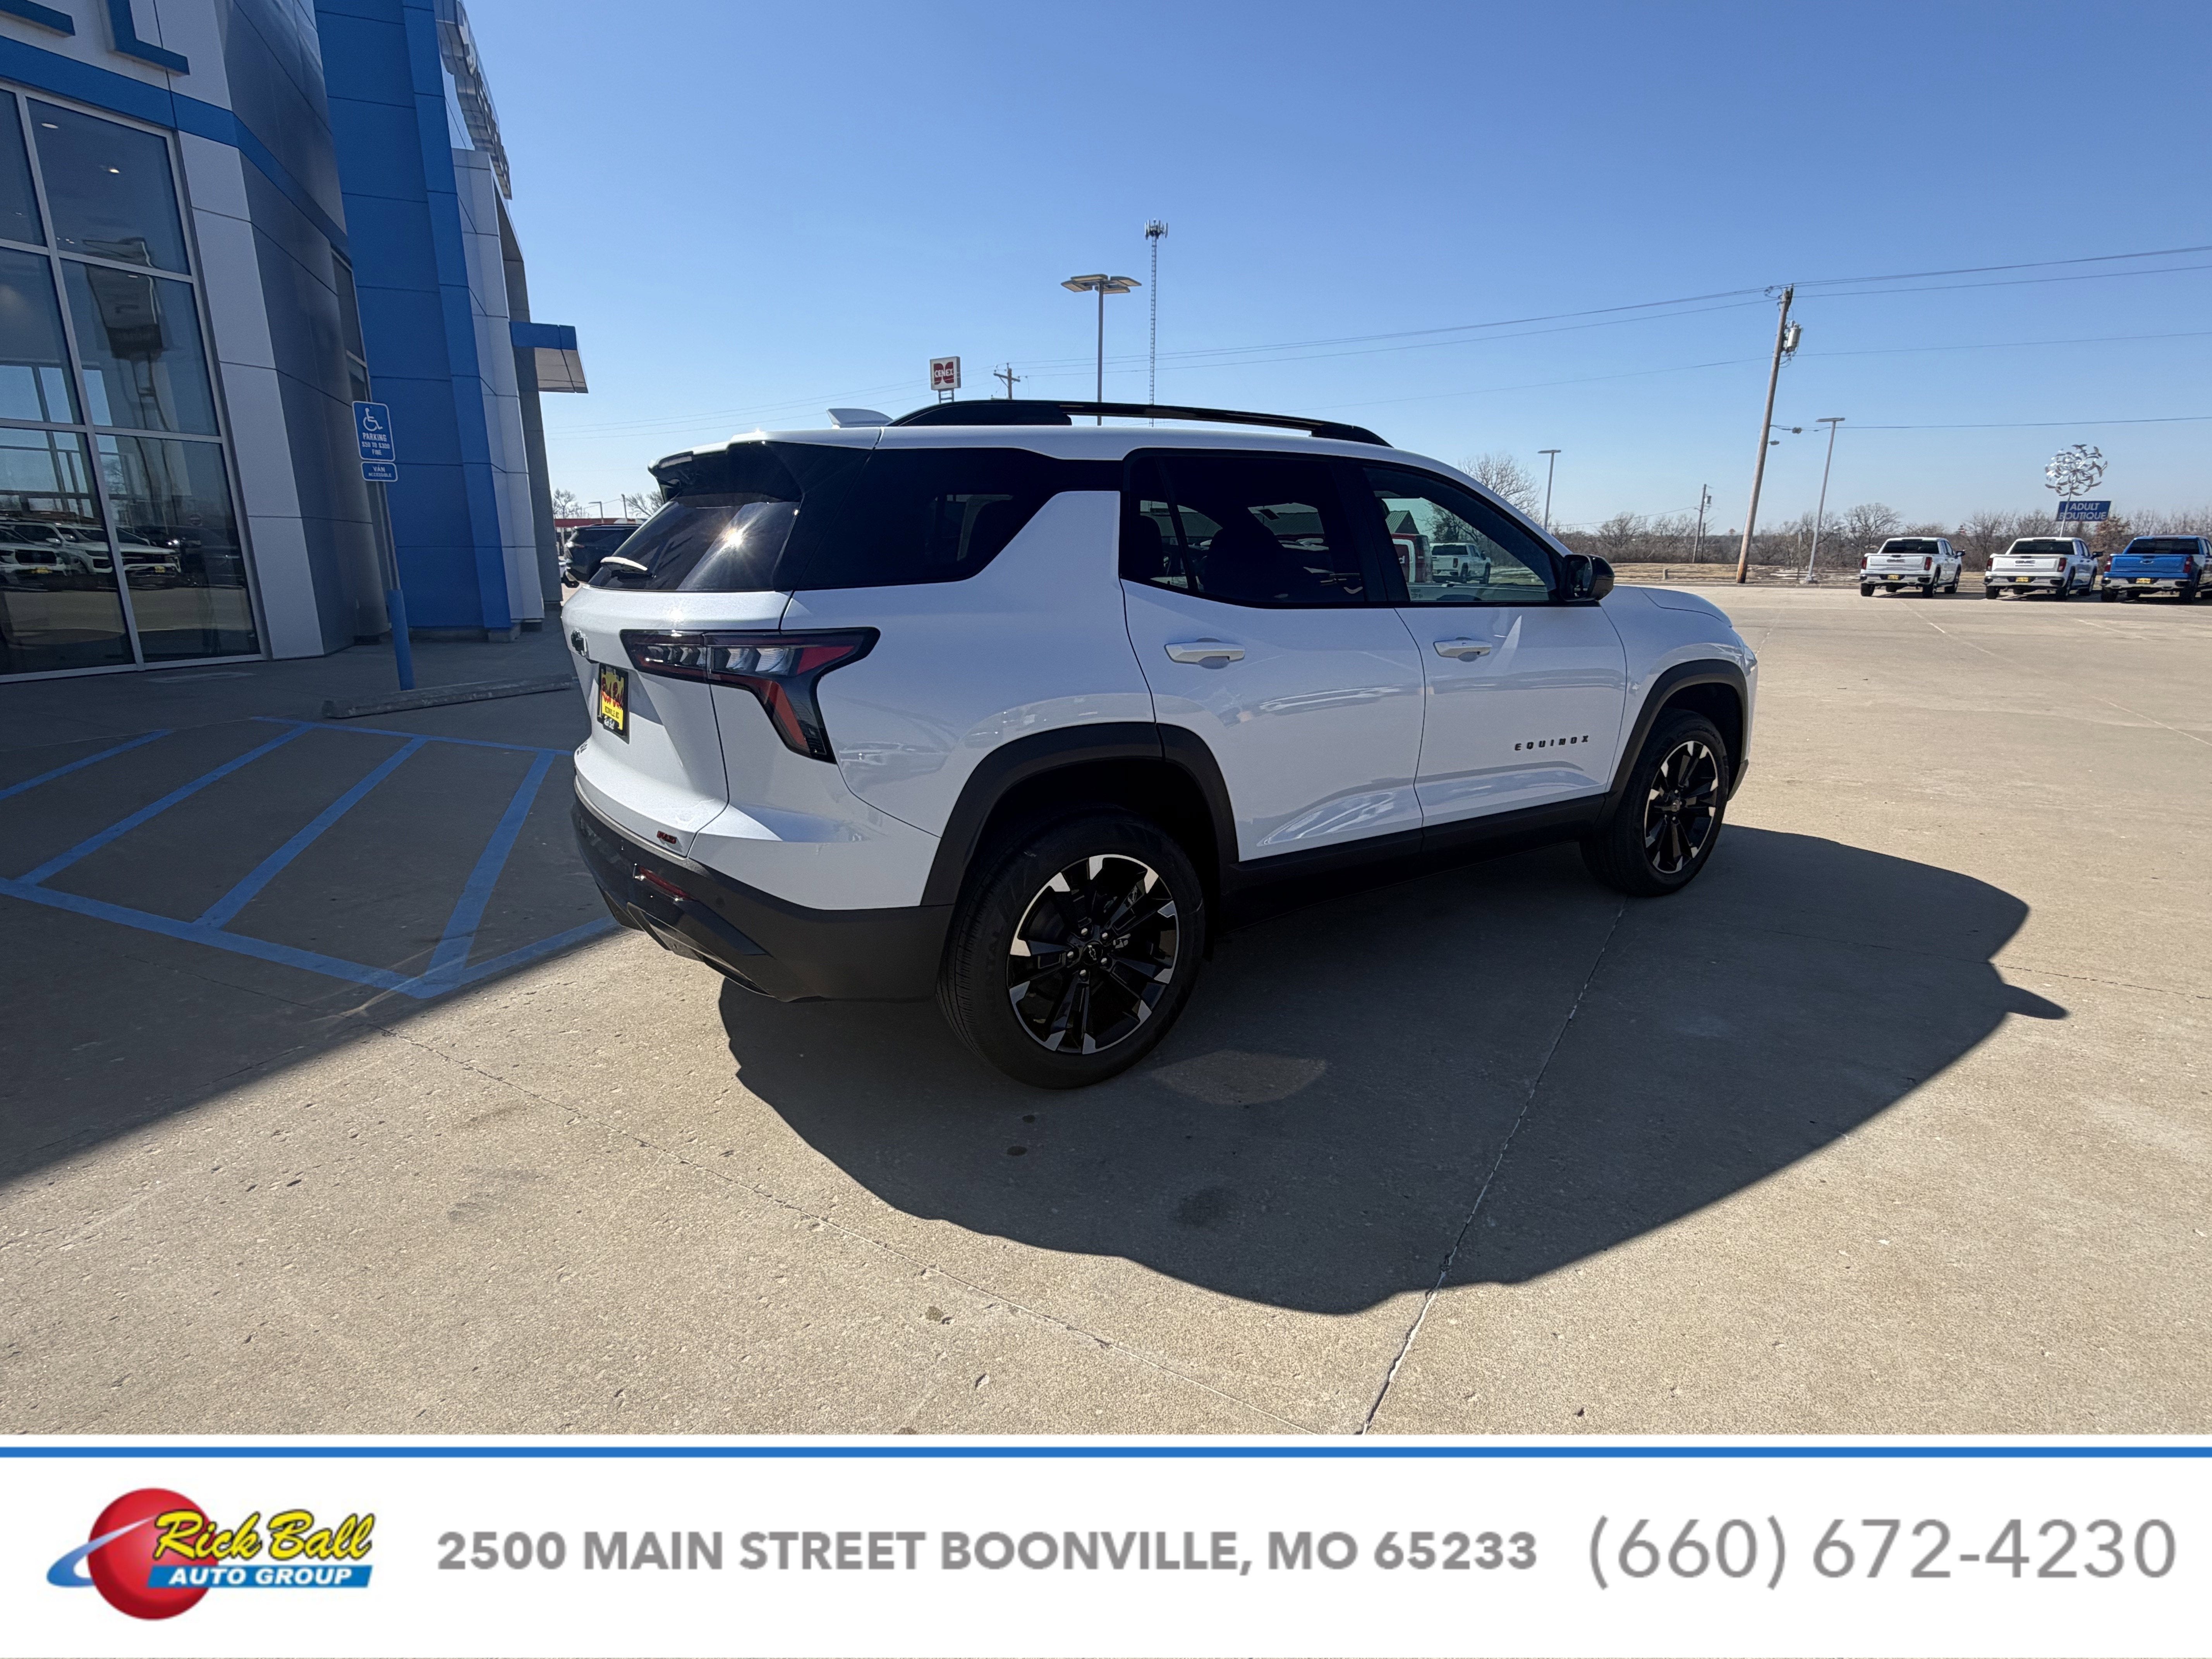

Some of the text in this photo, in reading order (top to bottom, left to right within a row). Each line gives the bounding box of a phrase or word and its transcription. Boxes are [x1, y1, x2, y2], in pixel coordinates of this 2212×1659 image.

[935, 369, 954, 378] CENEX
[362, 432, 387, 441] PARKING
[2059, 512, 2107, 520] BOUTIQUE
[1514, 735, 1589, 751] EQUINOX
